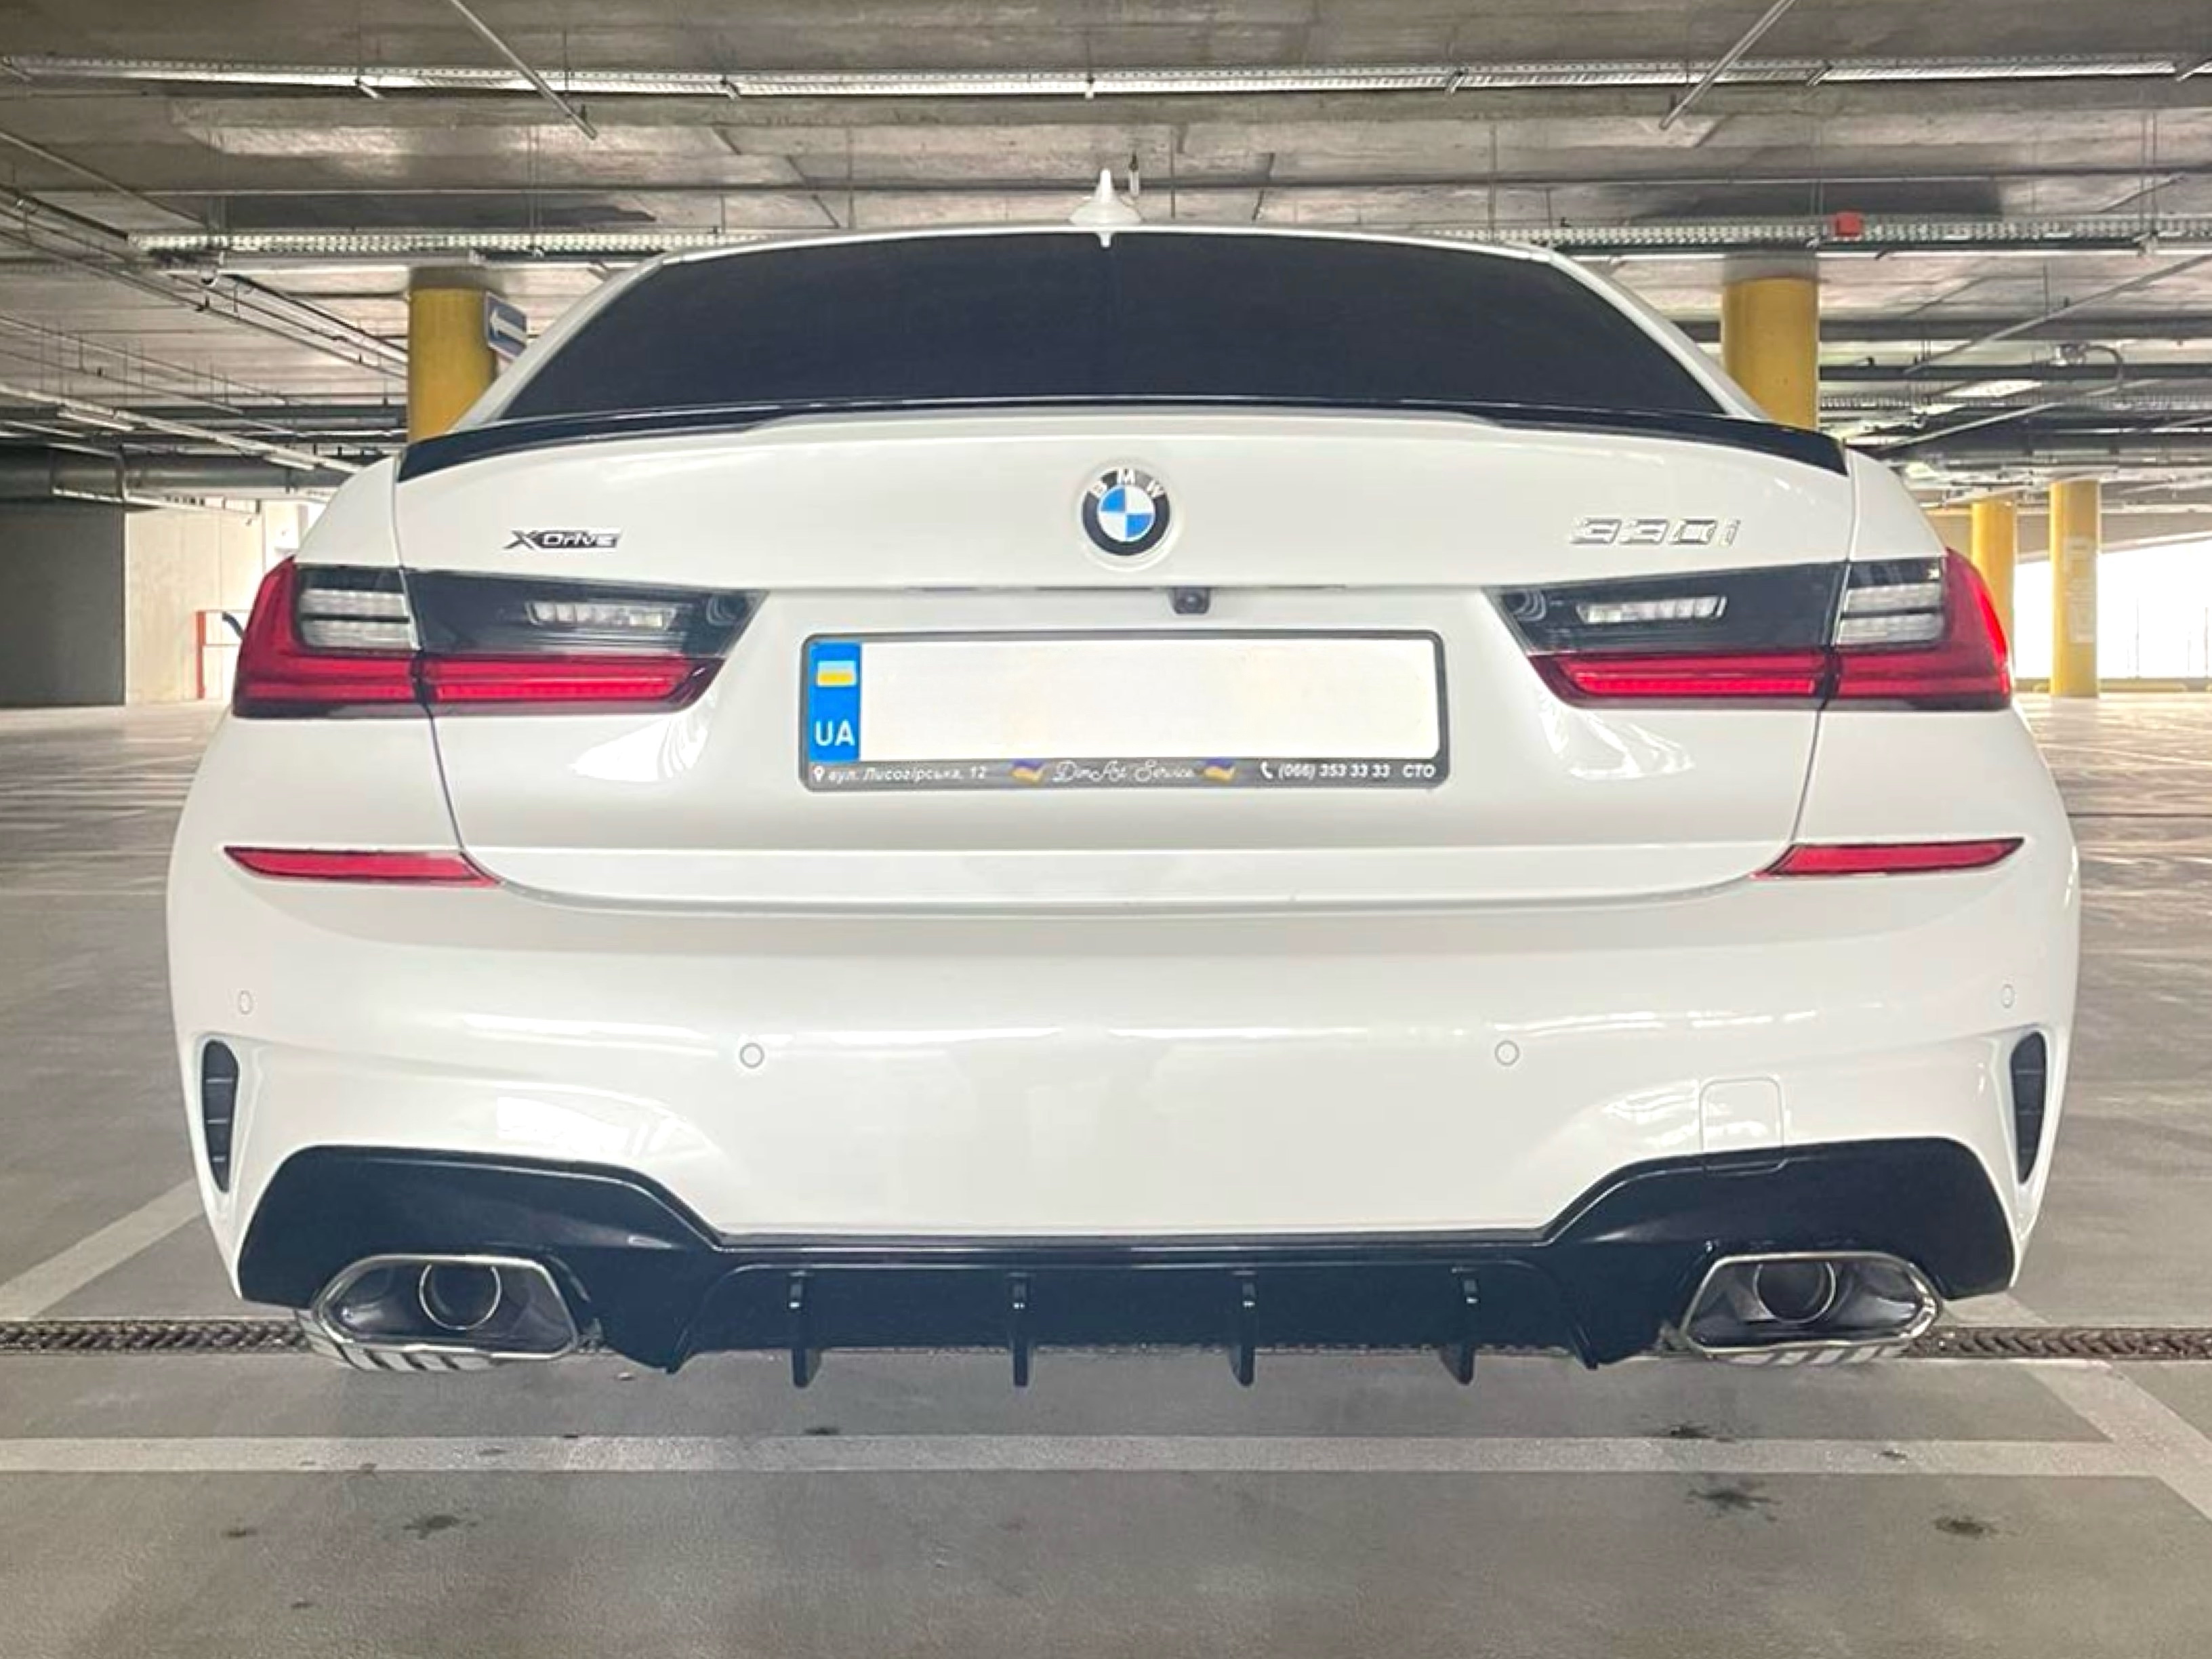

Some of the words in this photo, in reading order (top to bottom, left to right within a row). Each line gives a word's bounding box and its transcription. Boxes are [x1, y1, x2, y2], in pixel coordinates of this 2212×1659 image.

[1088, 468, 1166, 498] BMW
[1569, 517, 1741, 547] 330i
[815, 720, 855, 747] UA
[970, 765, 989, 779] 12
[1319, 762, 1347, 778] 353
[1349, 763, 1368, 778] 33
[1371, 763, 1390, 778] 33
